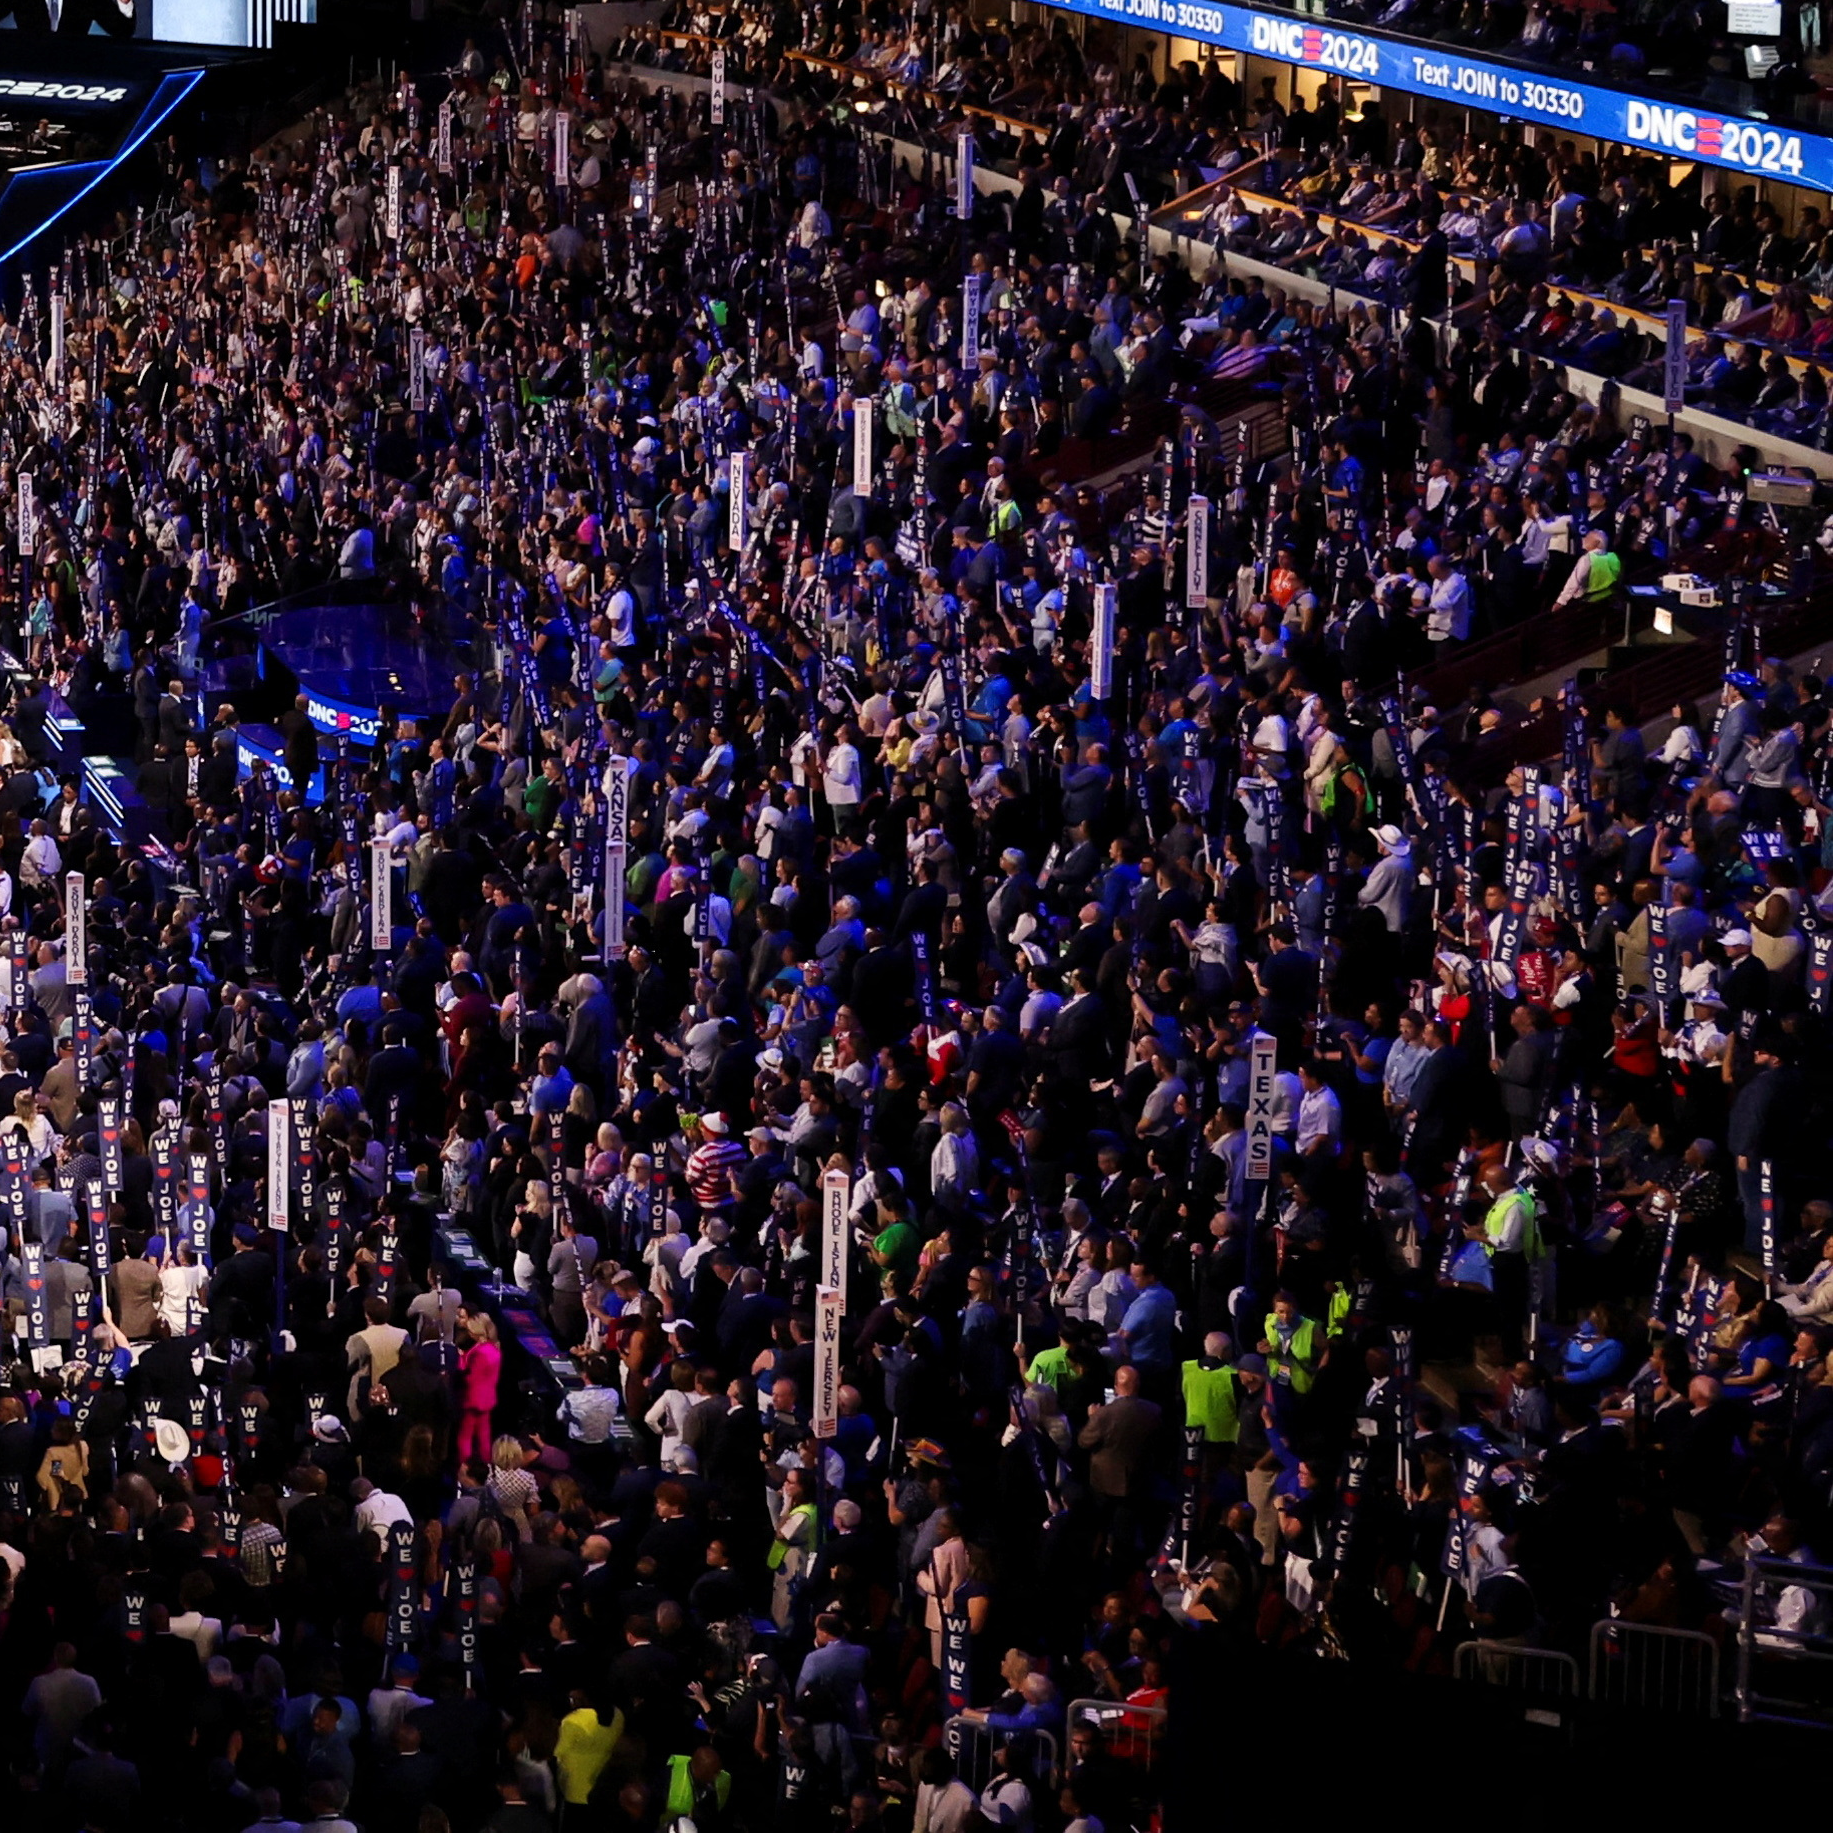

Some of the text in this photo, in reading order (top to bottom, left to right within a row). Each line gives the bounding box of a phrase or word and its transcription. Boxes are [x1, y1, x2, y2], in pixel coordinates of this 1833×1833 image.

[713, 58, 723, 114] GUAM
[1413, 57, 1582, 118] Text JOIN to 30330
[389, 175, 398, 228] IDAHO
[967, 287, 977, 358] WYOMING
[21, 483, 31, 544] OKLAHOMA
[731, 464, 740, 537] NEVADA
[611, 770, 624, 838] KANSA
[71, 886, 80, 968] SOUTH DAKOTA
[1649, 904, 1667, 993] WE JOE
[1252, 1053, 1273, 1159] TEXAS
[100, 1101, 120, 1190] WE JOE
[832, 1191, 841, 1236] RHODE
[25, 1245, 44, 1339] WE JOE
[823, 1308, 835, 1416] NEW JERSEY
[396, 1533, 413, 1633] WE JOE
